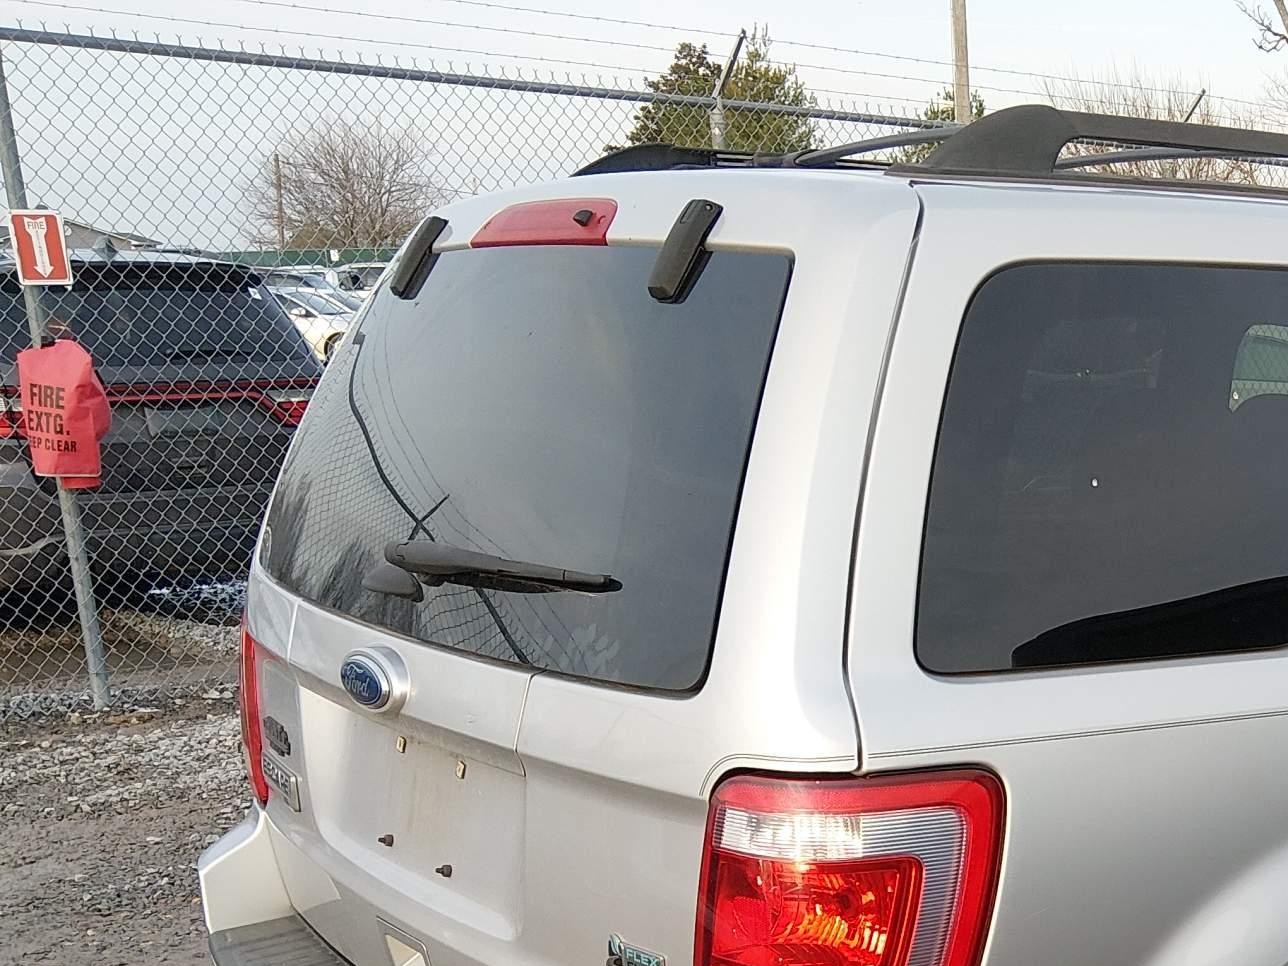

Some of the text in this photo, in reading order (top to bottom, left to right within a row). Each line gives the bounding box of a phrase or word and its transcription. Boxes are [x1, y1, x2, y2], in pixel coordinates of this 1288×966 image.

[29, 383, 65, 410] FIRE
[27, 409, 71, 436] EXTG.
[44, 437, 77, 453] CLEAR
[342, 663, 371, 698] Ford
